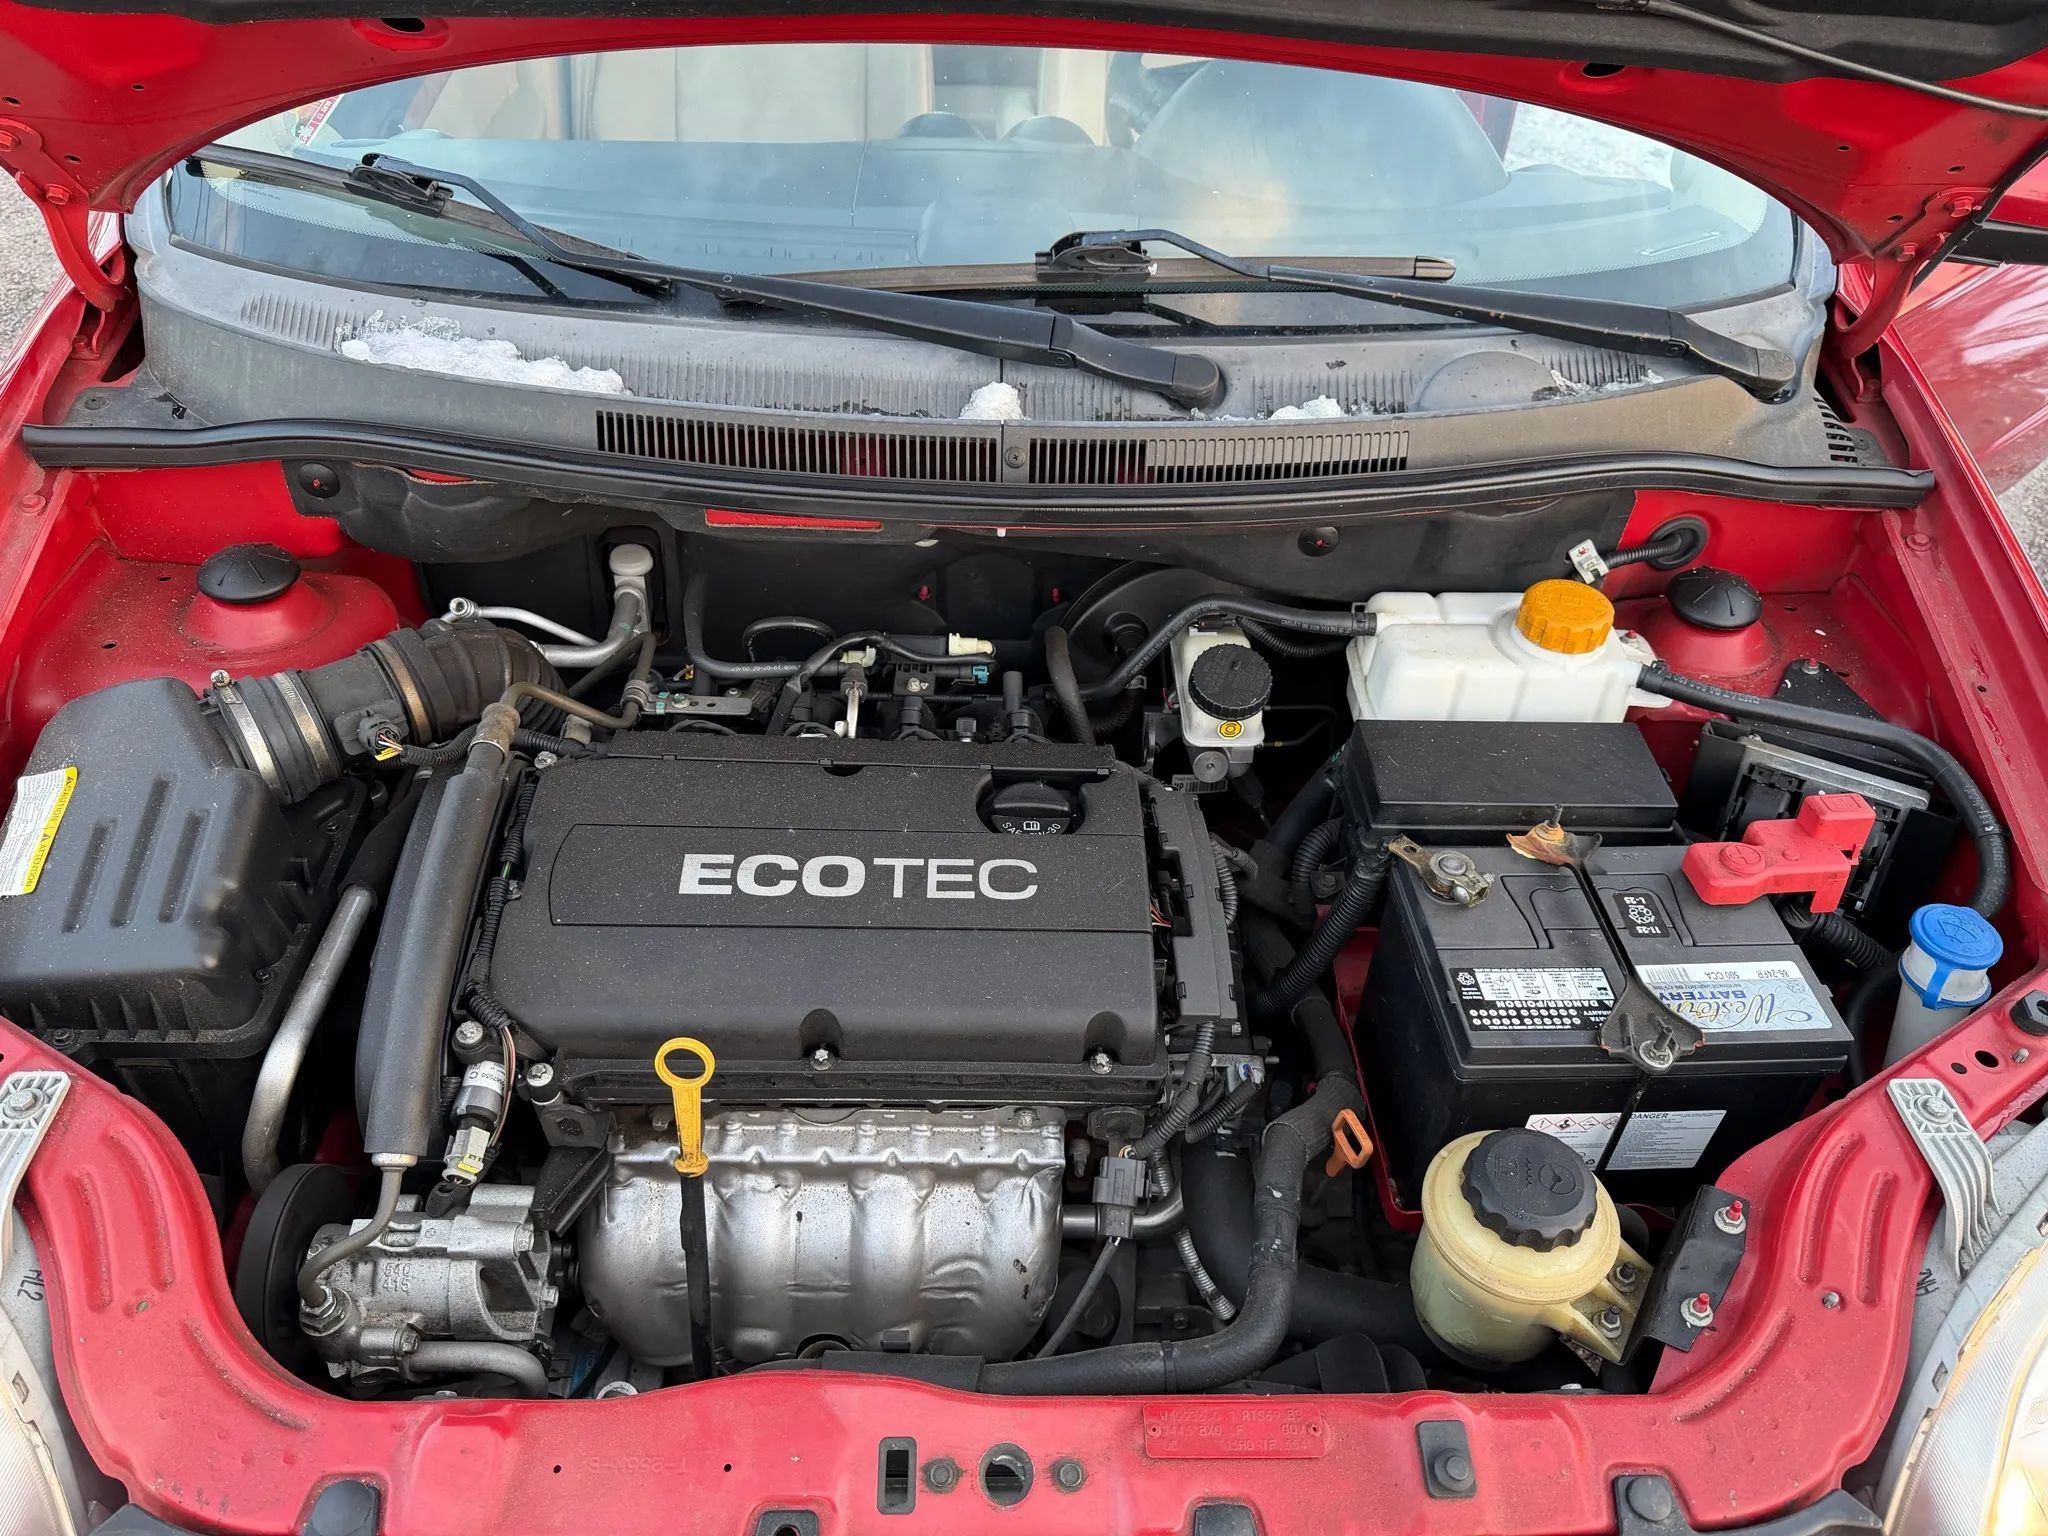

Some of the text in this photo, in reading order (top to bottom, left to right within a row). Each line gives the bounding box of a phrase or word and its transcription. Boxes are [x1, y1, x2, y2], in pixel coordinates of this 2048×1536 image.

[678, 853, 1039, 901] ECOTEC
[1659, 989, 1747, 1001] BATTERY
[1497, 1000, 1599, 1008] DANGER/POISON
